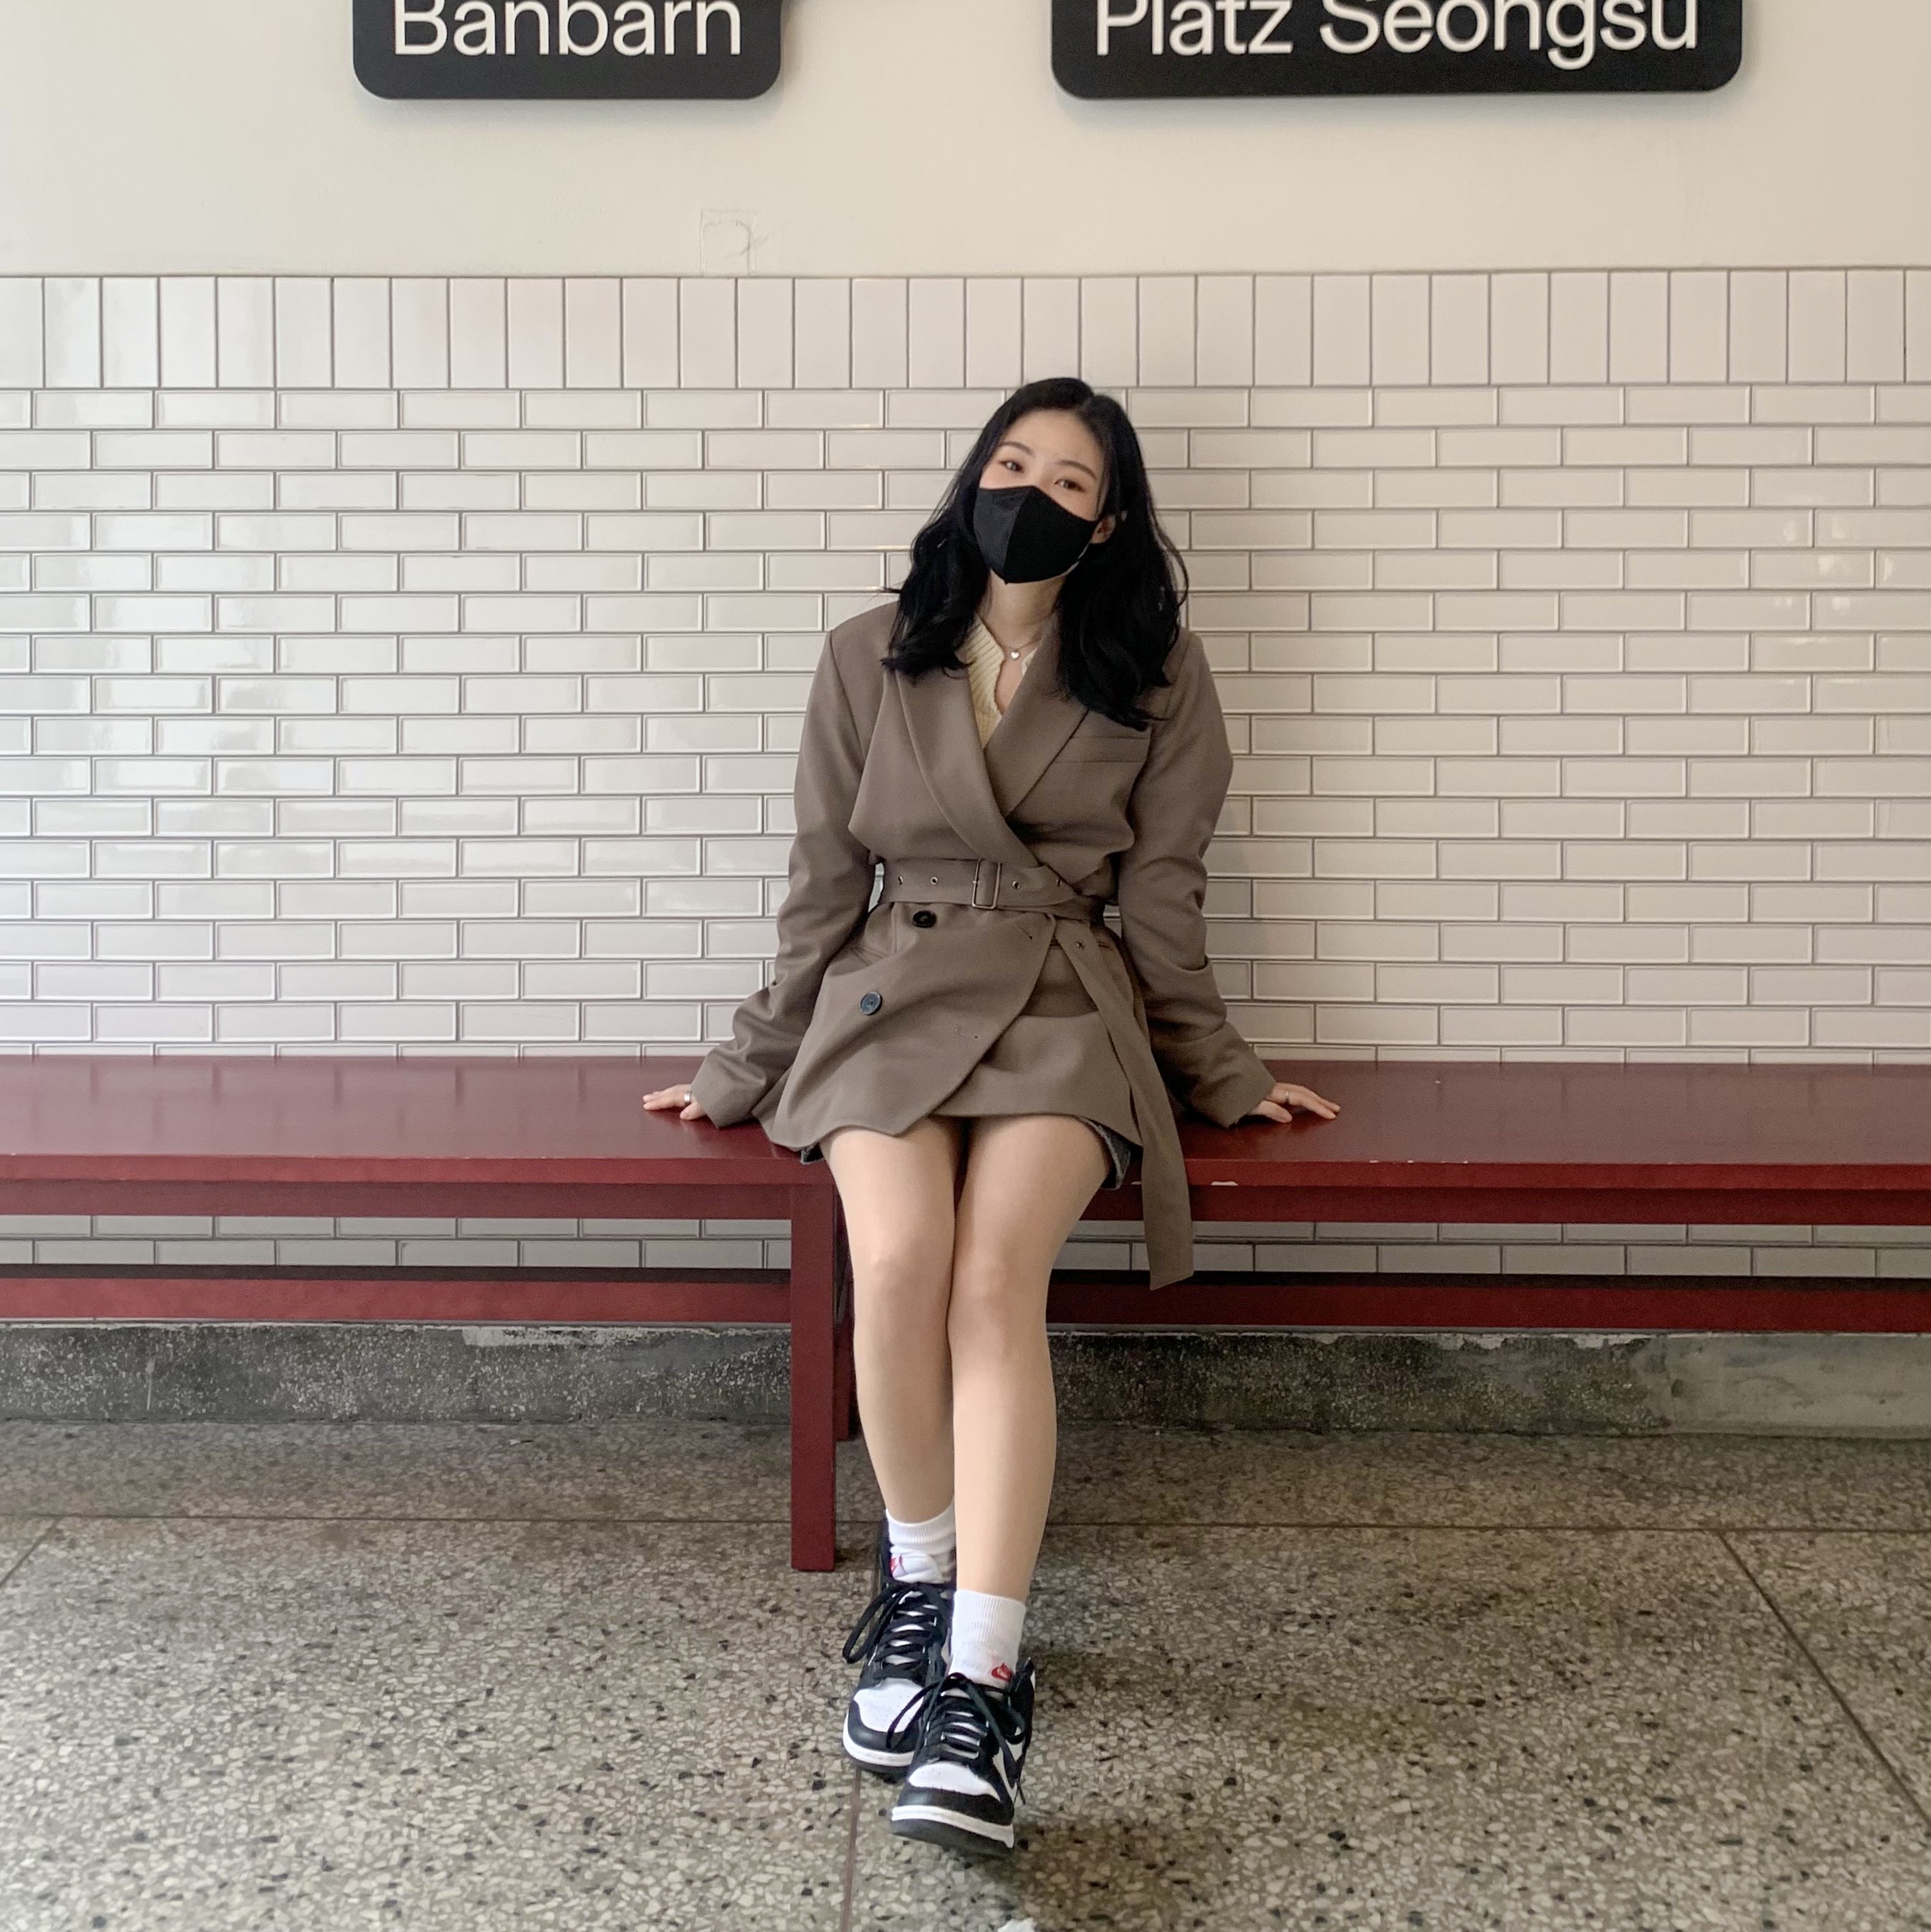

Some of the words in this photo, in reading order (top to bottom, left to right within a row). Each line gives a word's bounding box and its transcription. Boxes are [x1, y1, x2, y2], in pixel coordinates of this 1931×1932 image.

[394, 0, 741, 56] Banbarn
[1096, 0, 1293, 55] Platz
[1319, 0, 1698, 70] Seongsu
